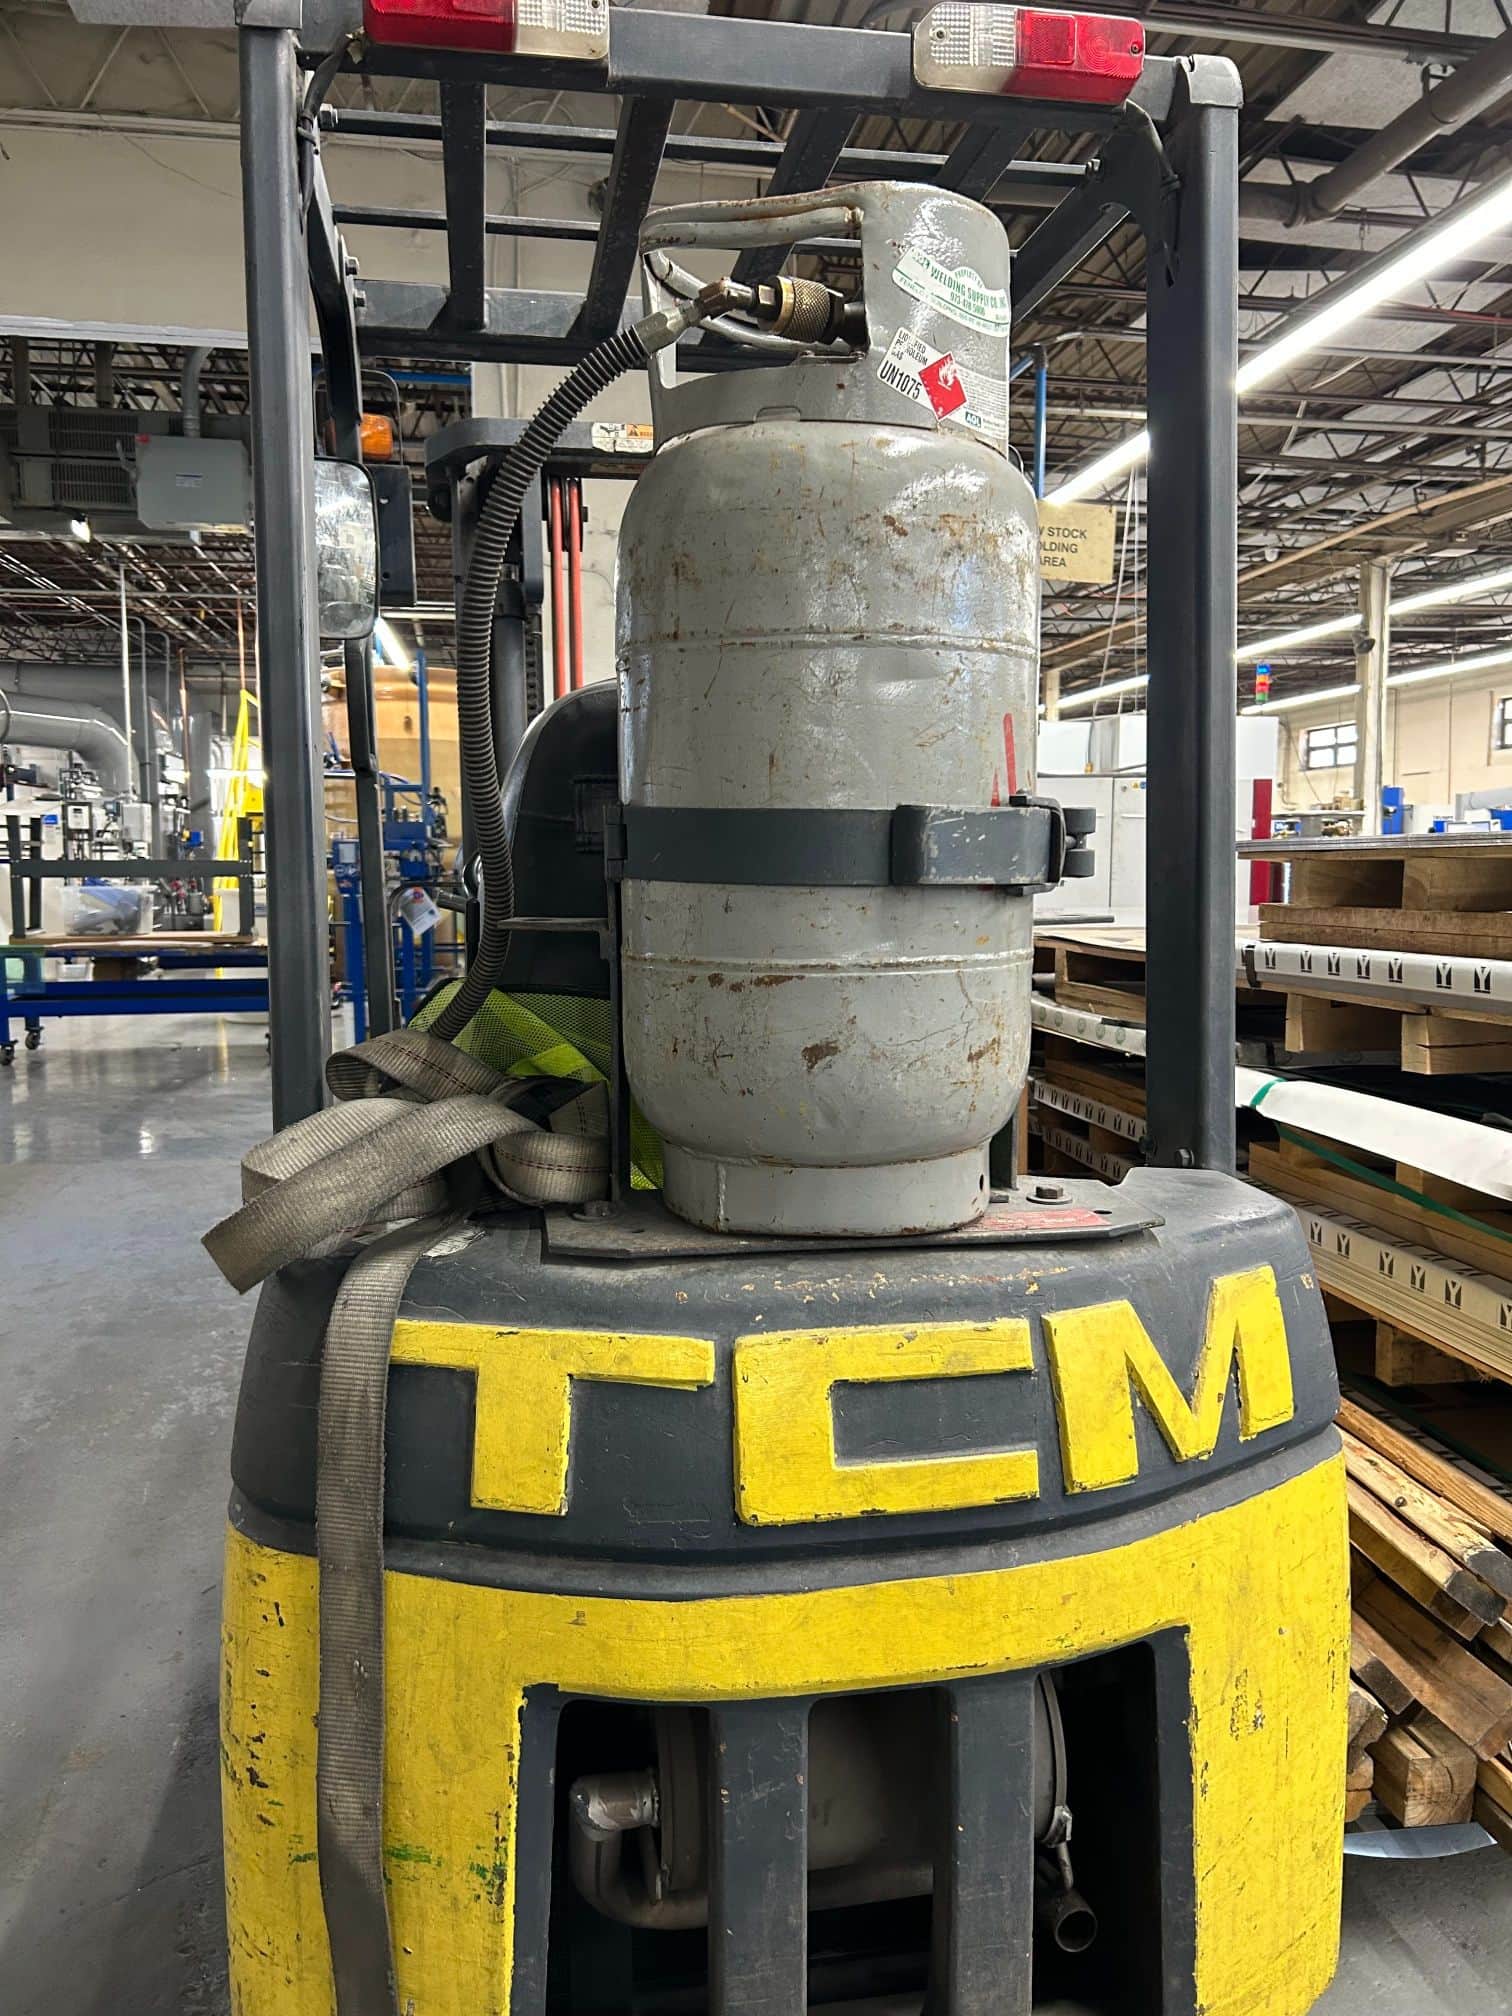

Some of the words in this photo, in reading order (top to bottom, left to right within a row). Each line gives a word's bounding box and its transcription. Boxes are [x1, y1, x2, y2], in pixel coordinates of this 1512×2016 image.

[930, 265, 966, 296] WELDING
[899, 331, 927, 353] LIQFIED
[880, 360, 922, 400] UN1075
[1047, 527, 1088, 540] STOCK
[390, 1265, 1294, 1526] TCM
